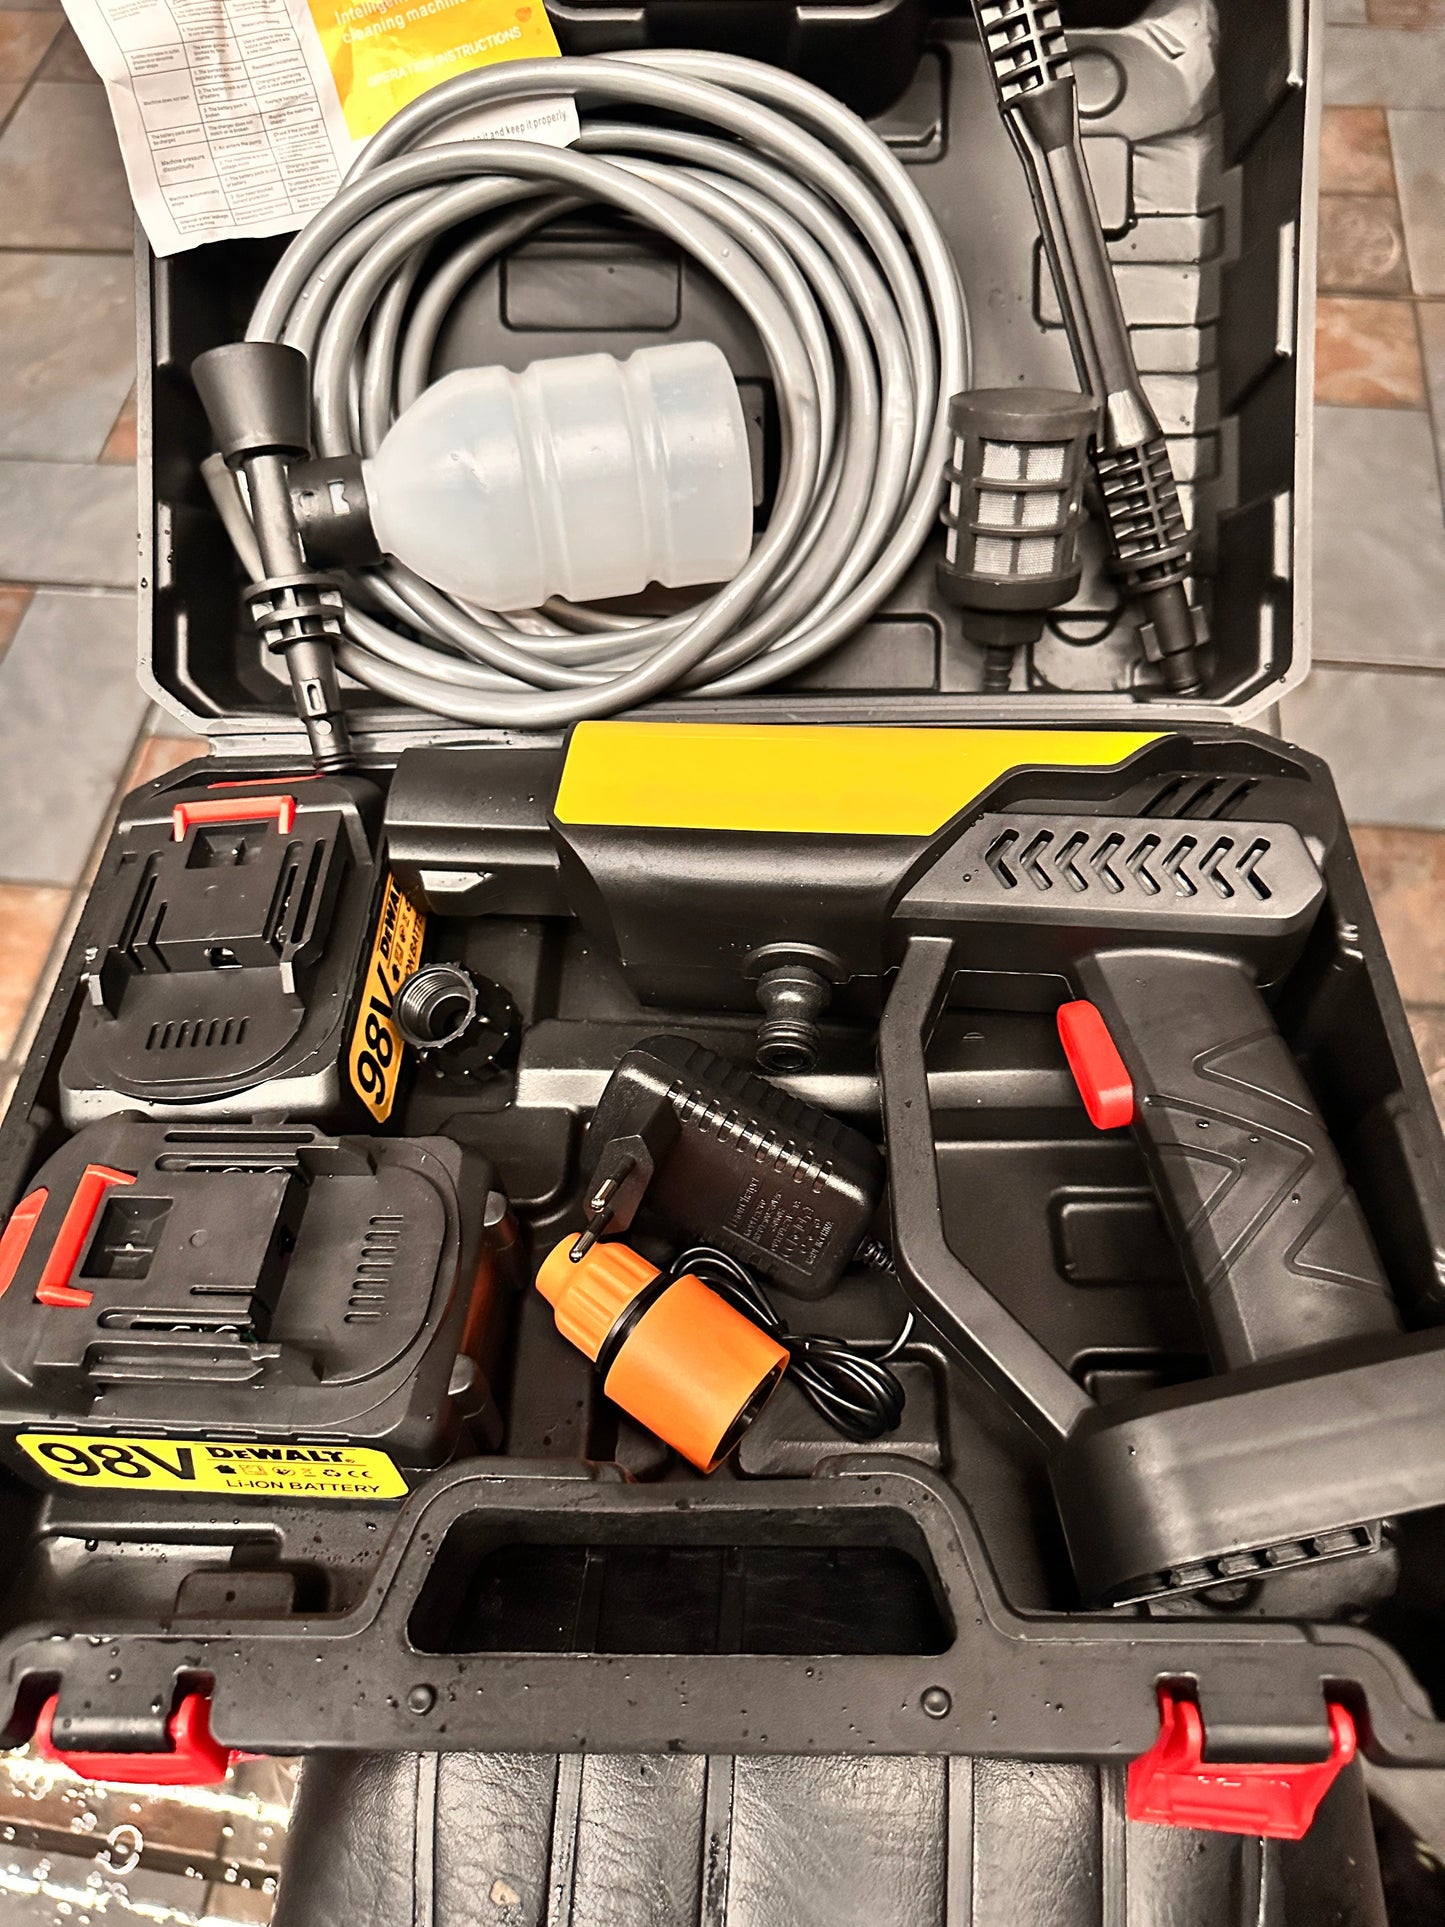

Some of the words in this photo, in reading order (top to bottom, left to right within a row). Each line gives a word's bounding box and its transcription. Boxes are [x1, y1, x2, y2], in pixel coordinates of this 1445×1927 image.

[334, 0, 408, 25] Intellige
[436, 25, 522, 64] INSTRUCTIONS
[490, 127, 505, 140] and
[506, 122, 526, 135] keep
[357, 961, 395, 1106] 98V
[38, 1441, 197, 1481] 98V
[226, 1479, 284, 1490] Li-ION
[290, 1481, 380, 1493] BATTERY
